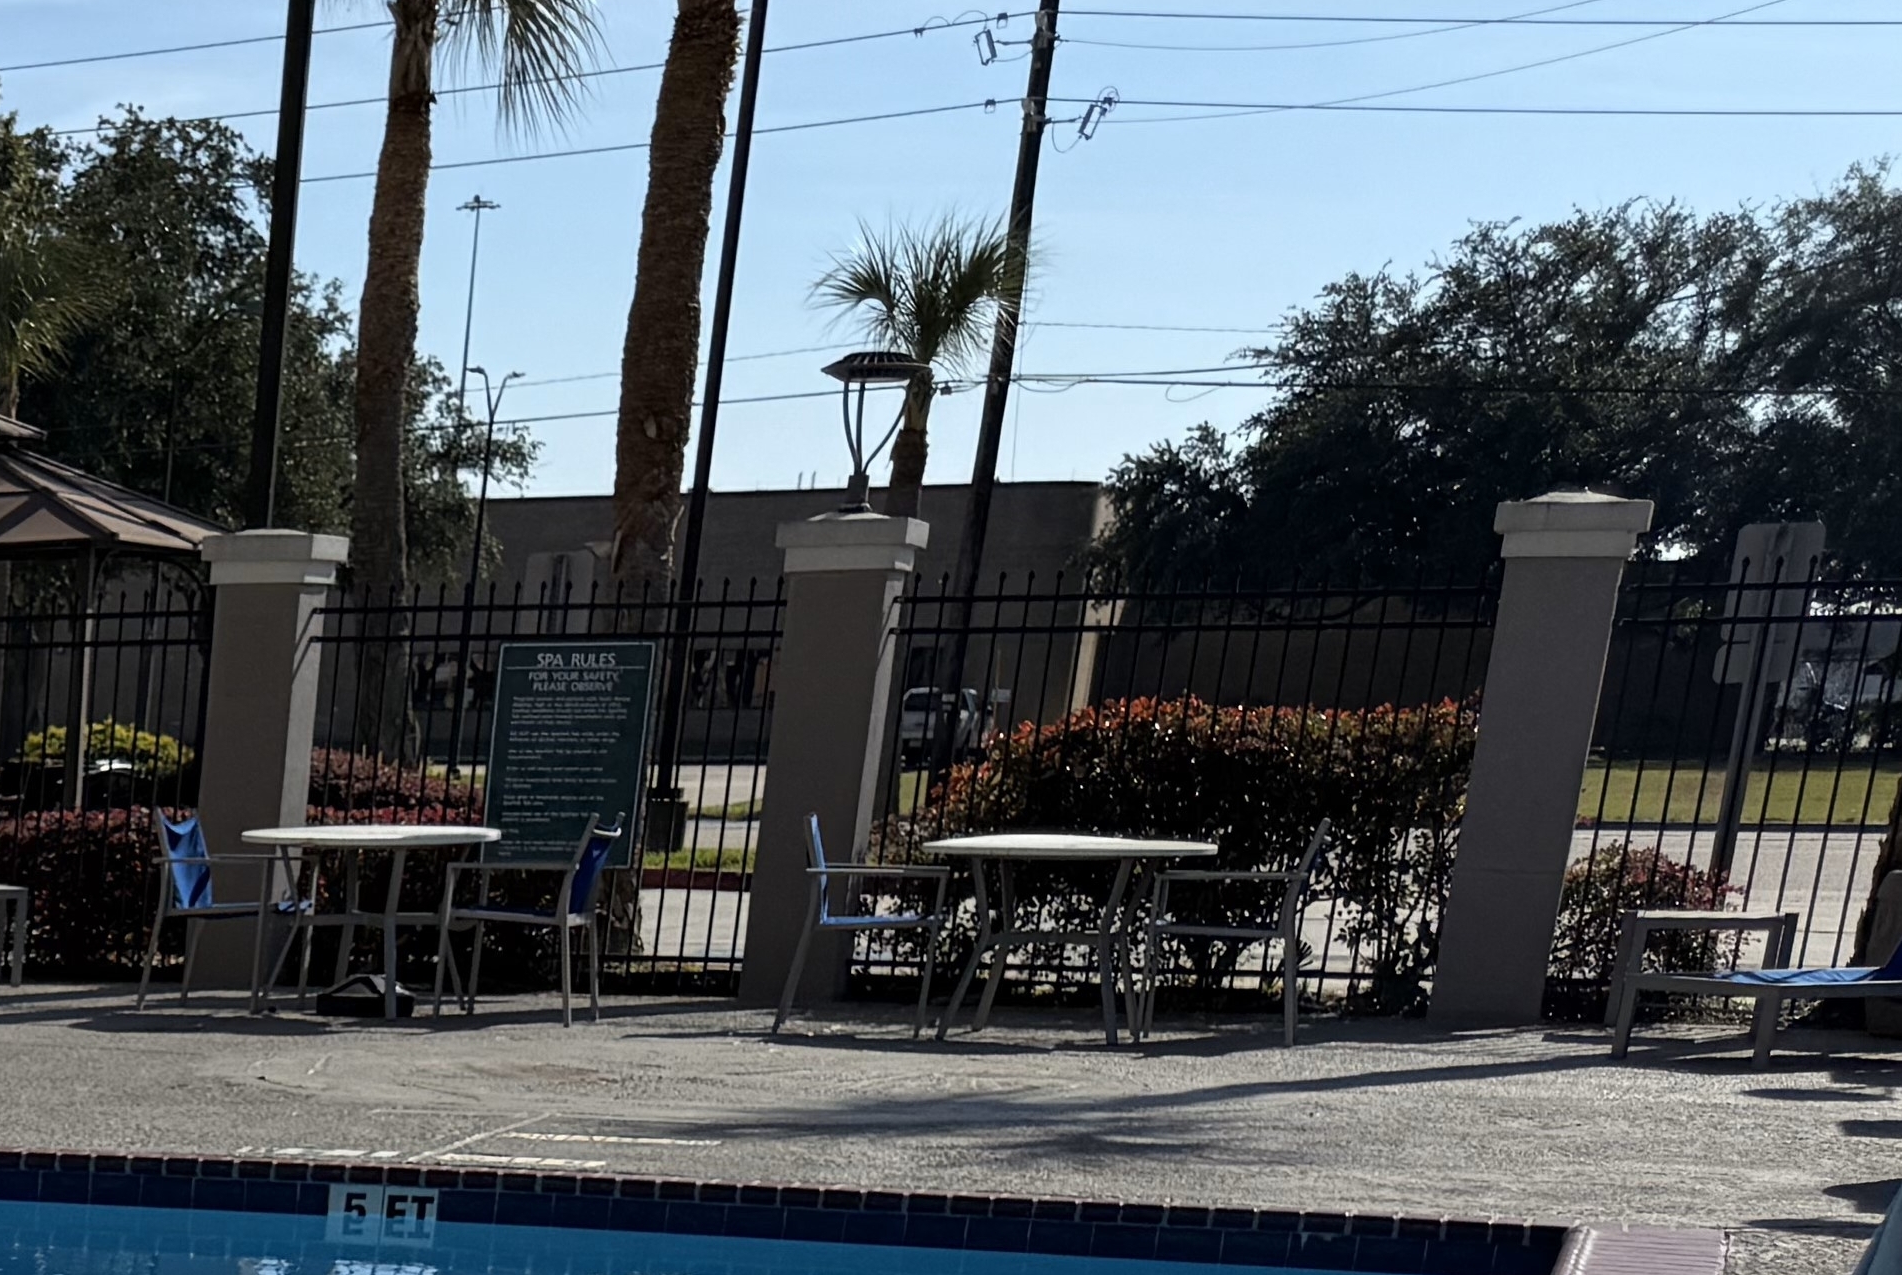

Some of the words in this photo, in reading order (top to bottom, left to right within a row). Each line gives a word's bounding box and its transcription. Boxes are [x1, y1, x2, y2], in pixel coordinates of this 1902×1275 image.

[537, 652, 564, 667] SPA
[571, 652, 617, 667] RULES
[528, 671, 548, 681] FOR
[551, 671, 579, 681] YOUR
[533, 681, 566, 691] PLEASE
[571, 681, 614, 691] OBSERVE
[344, 1193, 367, 1217] 5
[387, 1194, 435, 1220] FT
